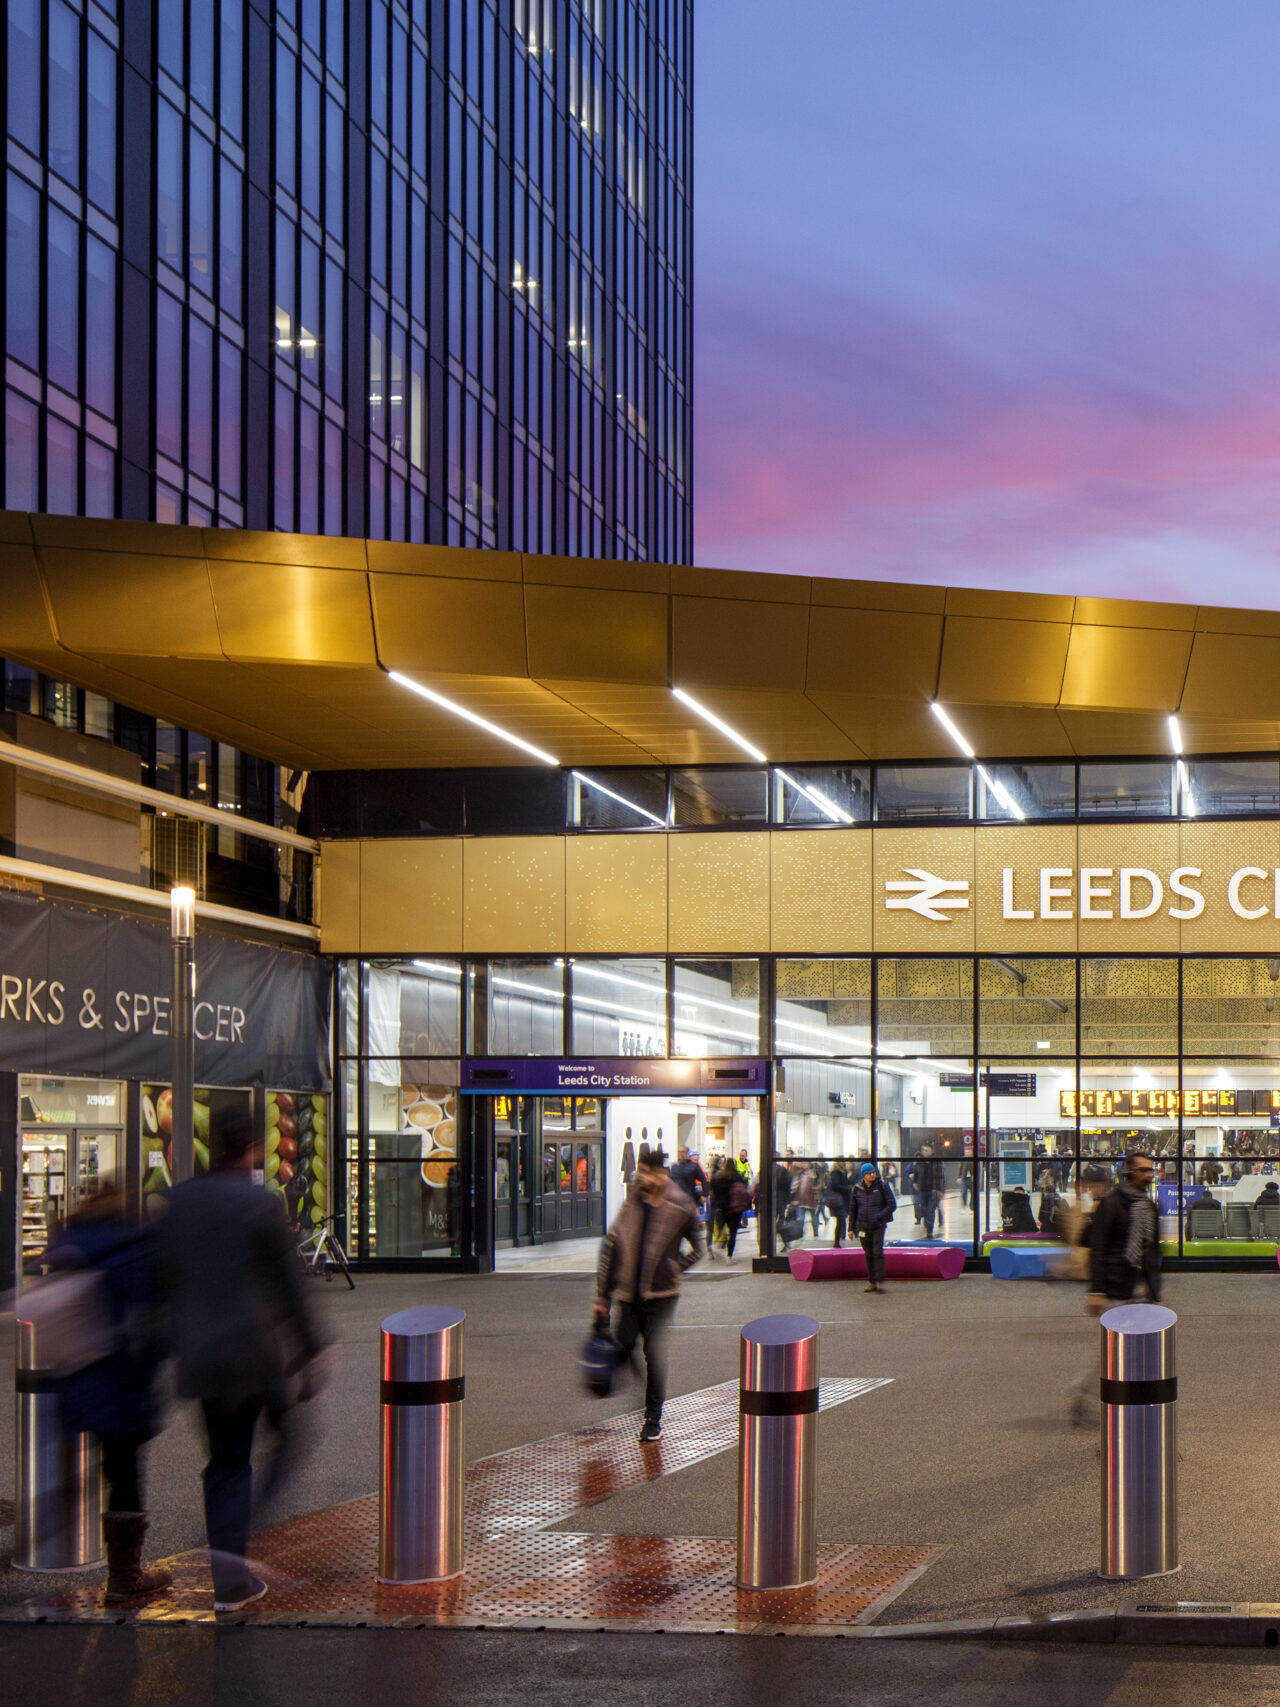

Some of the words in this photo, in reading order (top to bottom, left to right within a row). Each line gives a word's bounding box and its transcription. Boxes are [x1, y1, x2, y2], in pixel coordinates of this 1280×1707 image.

[1002, 866, 1205, 919] LEEDS
[78, 988, 103, 1029] &
[114, 990, 245, 1043] SPECER
[558, 1075, 589, 1085] Leeds
[590, 1075, 612, 1087] City
[613, 1075, 650, 1085] Station
